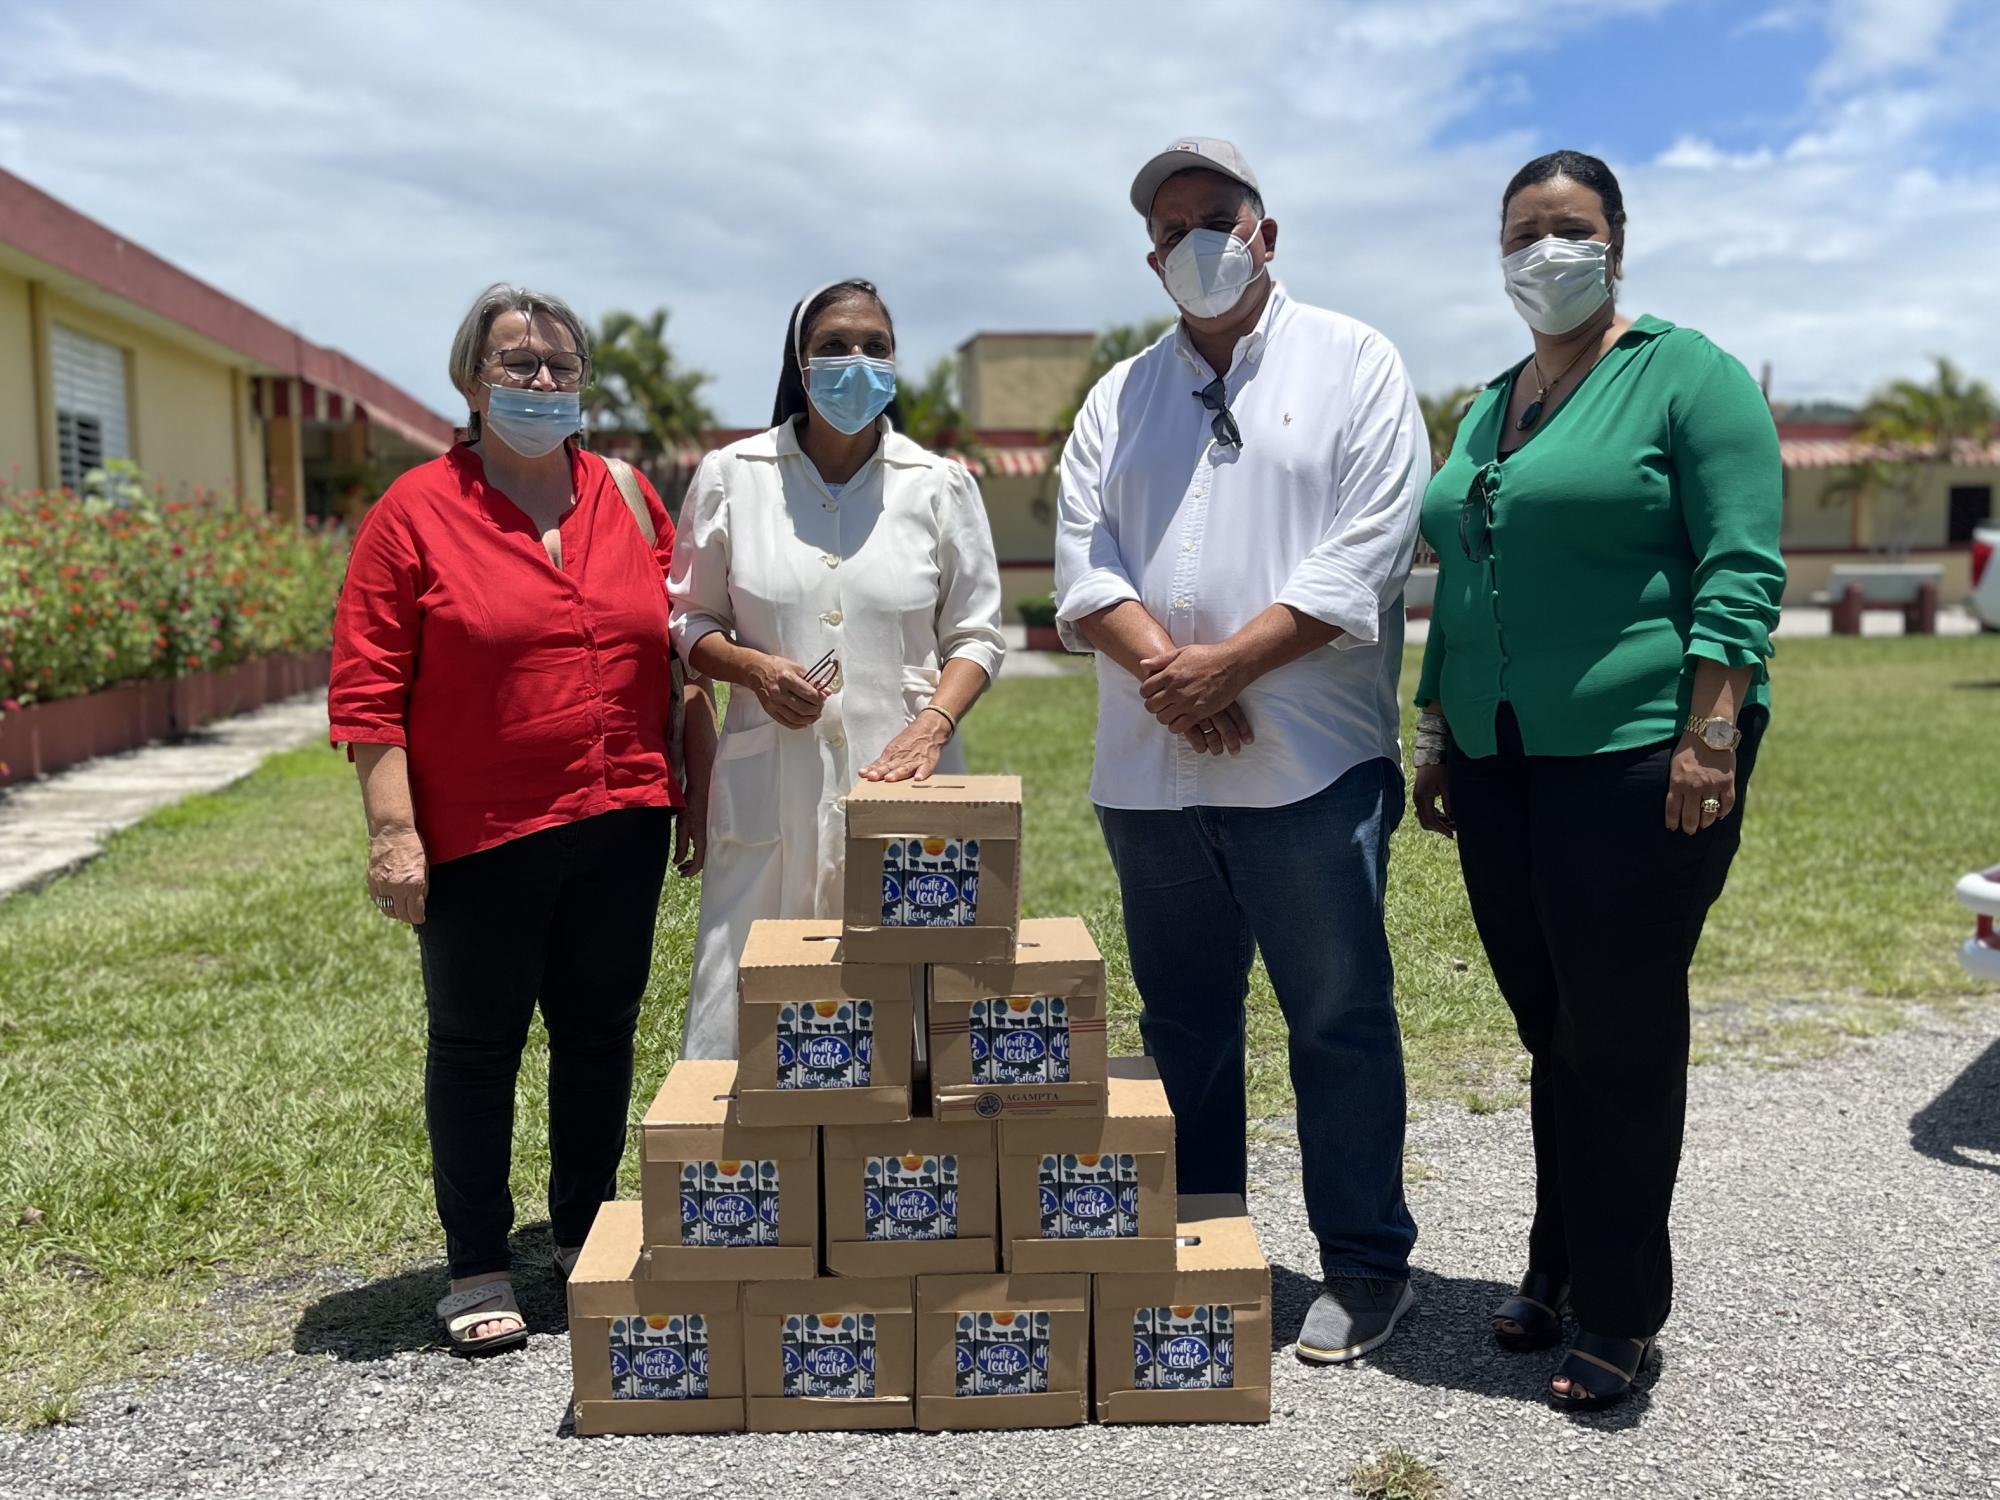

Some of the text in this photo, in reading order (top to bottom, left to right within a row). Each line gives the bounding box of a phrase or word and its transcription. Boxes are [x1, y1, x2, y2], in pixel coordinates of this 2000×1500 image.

[909, 877, 940, 891] Monte
[908, 909, 932, 921] Leche
[802, 1040, 833, 1053] Monte
[996, 1034, 1027, 1048] Monte
[802, 1071, 825, 1084] Leche
[996, 1066, 1020, 1079] Leche
[889, 1193, 920, 1207] Monte
[1066, 1189, 1097, 1203] Monte
[706, 1197, 737, 1211] Monte
[890, 1224, 913, 1236] Leche
[1067, 1221, 1090, 1233] Leche
[706, 1229, 729, 1241] Leche
[980, 1347, 1011, 1360] Monte
[1161, 1340, 1192, 1354] Monte
[636, 1351, 666, 1365] Monte
[808, 1349, 838, 1362] Monte
[981, 1378, 1003, 1389] Leche
[1161, 1372, 1185, 1384] Leche
[637, 1382, 660, 1394] Leche
[808, 1380, 830, 1391] Leche
